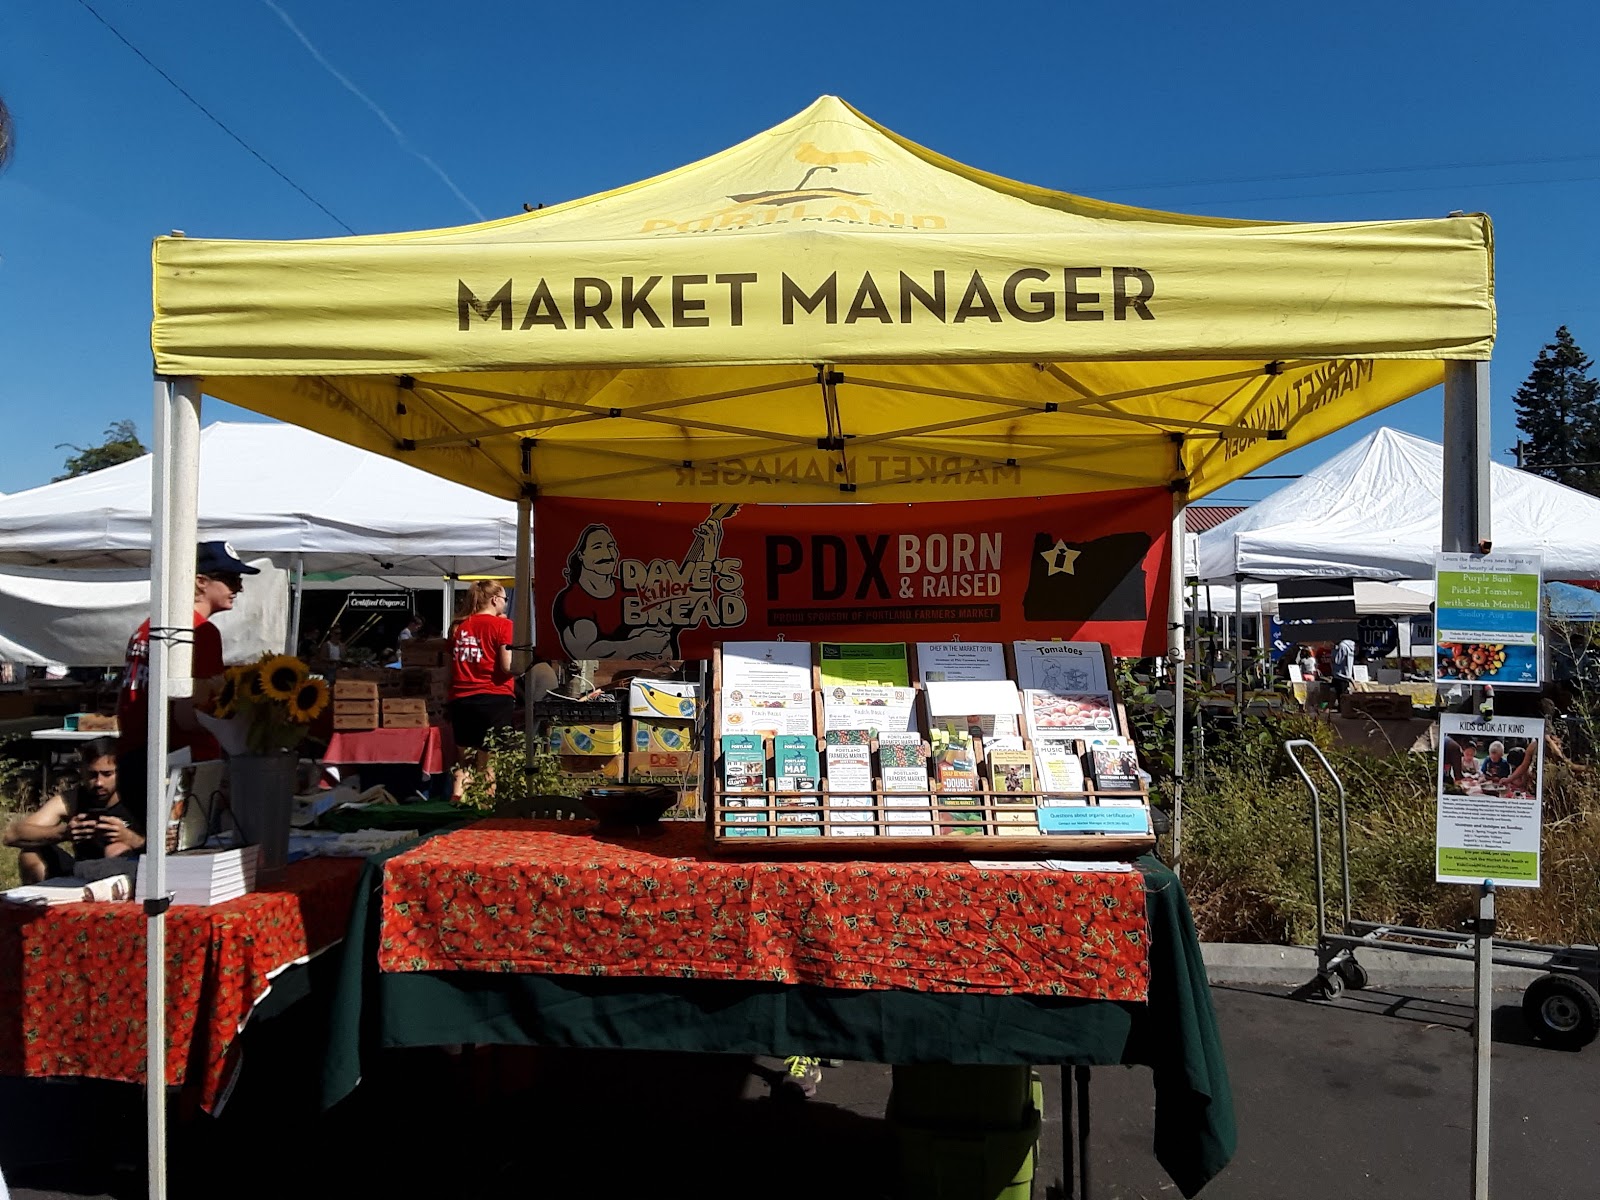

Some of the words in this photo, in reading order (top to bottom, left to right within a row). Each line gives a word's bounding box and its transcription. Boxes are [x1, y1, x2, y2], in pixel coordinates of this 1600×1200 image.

[640, 205, 947, 233] PORTLAND
[458, 272, 758, 331] MARKET
[781, 266, 1156, 325] MANAGER
[765, 534, 892, 601] PDX
[898, 532, 1002, 574] BORN
[621, 560, 743, 592] DAVE'S
[1463, 573, 1489, 584] Purple
[1492, 574, 1512, 583] Basil
[899, 576, 914, 599] &
[923, 573, 1001, 598] RAISED
[1451, 586, 1481, 595] Pickled
[1484, 587, 1523, 596] Tomatoes
[1444, 598, 1463, 607] with
[1466, 599, 1490, 608] Sarah
[1493, 600, 1531, 609] Marshall
[623, 595, 746, 627] BREAD
[773, 611, 804, 622] PROUD
[807, 611, 849, 622] SPONSOR
[851, 611, 863, 621] OF
[866, 609, 912, 620] PORTLAND
[914, 608, 956, 619] FARMERS
[958, 607, 995, 619] MARKET
[1457, 609, 1486, 619] Sunday
[1488, 611, 1504, 619] Aug
[1036, 645, 1083, 656] Tomatoes
[1459, 721, 1476, 732] KIDS
[1476, 722, 1496, 733] COOK
[1497, 723, 1507, 733] AT
[1508, 724, 1525, 734] KING
[650, 753, 678, 765] Dole
[784, 765, 807, 774] MAP
[946, 778, 973, 788] DOUBLE
